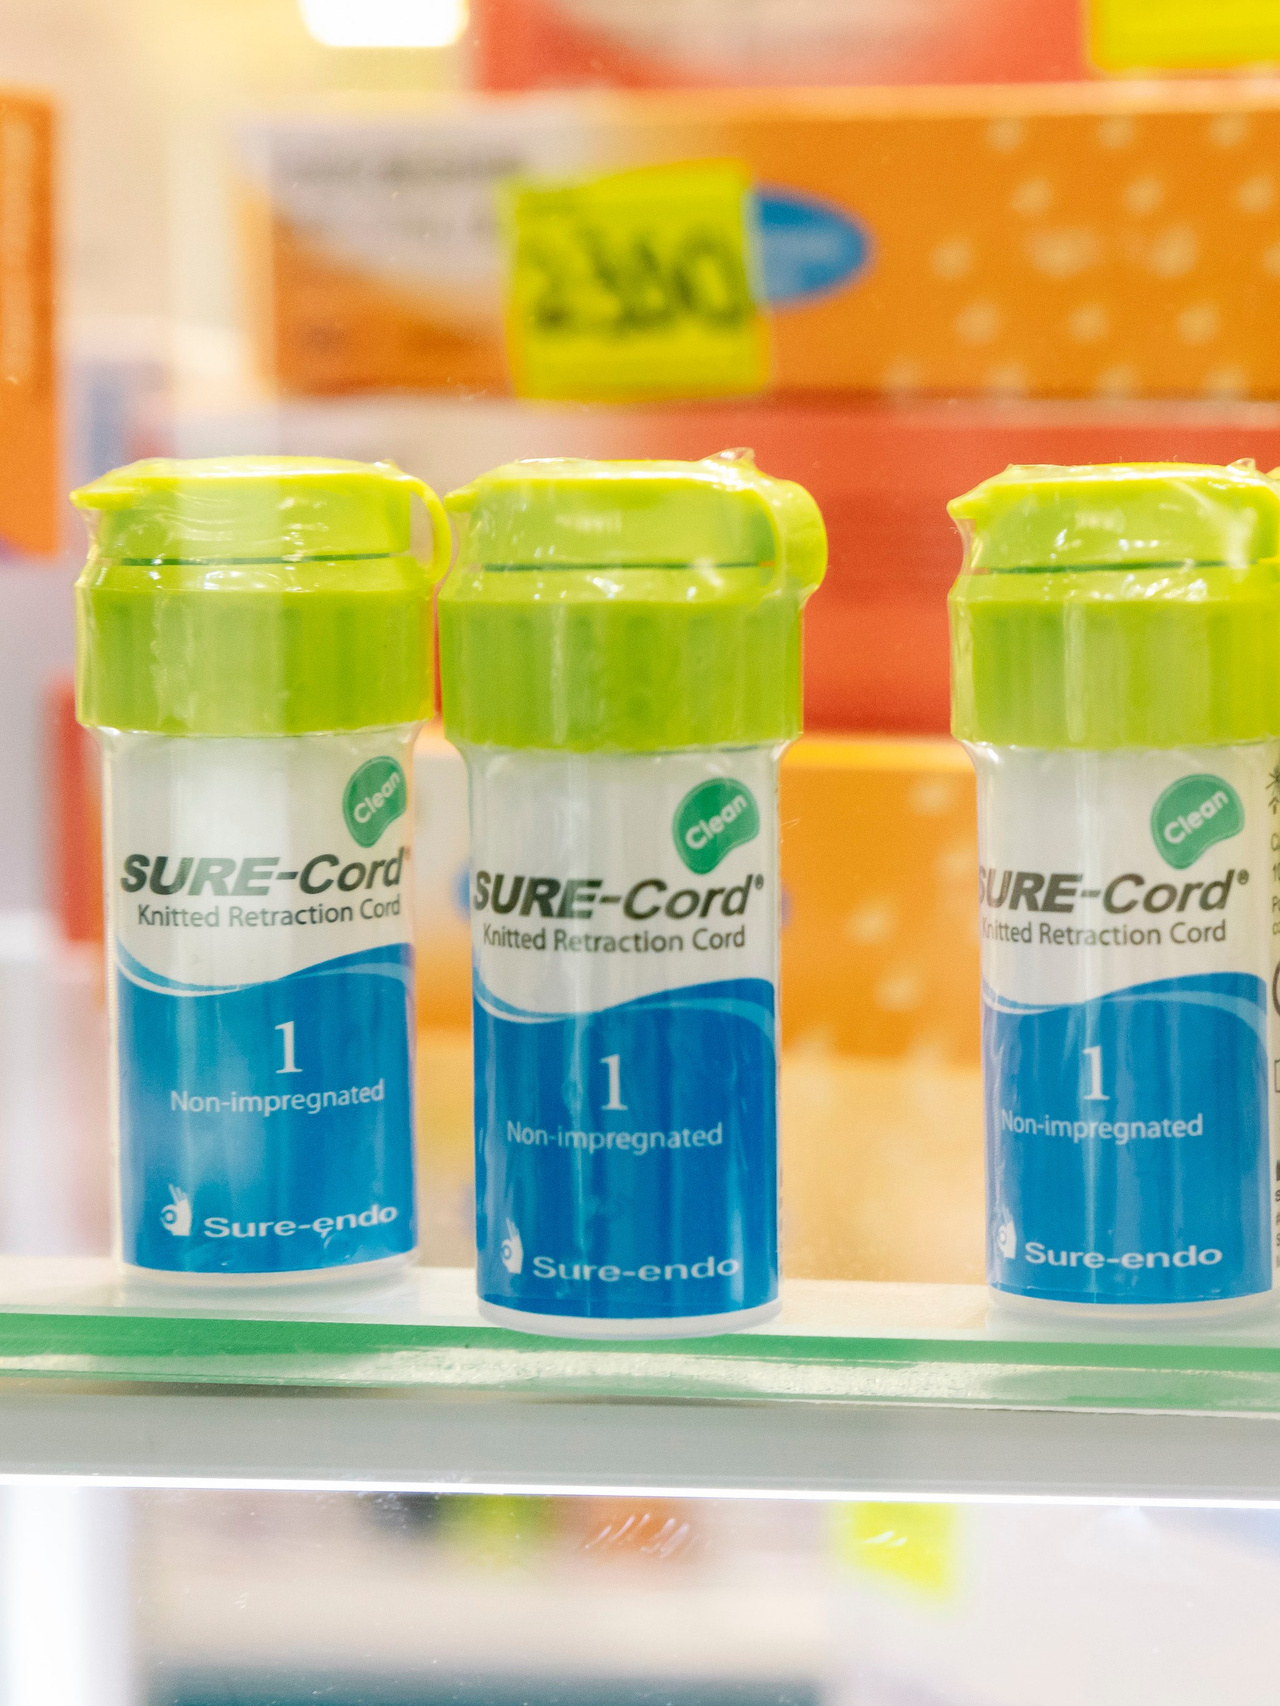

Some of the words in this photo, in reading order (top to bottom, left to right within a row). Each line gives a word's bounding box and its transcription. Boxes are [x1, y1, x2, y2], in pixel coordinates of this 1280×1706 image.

[352, 770, 401, 825] Clean
[685, 794, 747, 849] Clean
[1163, 790, 1229, 845] Clean
[138, 904, 220, 927] Knitted
[229, 904, 353, 927] Retraction
[360, 893, 400, 919] Cord
[483, 922, 546, 951] Knitted
[553, 928, 684, 953] Retraction
[692, 924, 745, 951] Cord
[1039, 921, 1162, 946] Retraction
[1170, 919, 1227, 945] Cord
[274, 1020, 303, 1074] 1
[600, 1053, 628, 1111] 1
[1083, 1045, 1110, 1101] 1
[169, 1078, 385, 1117] Non-impregnated
[506, 1120, 723, 1156] Non-impregnated
[1001, 1108, 1204, 1145] Non-impregnated
[204, 1204, 398, 1238] Sure-endo
[533, 1256, 740, 1282] Sure-endo
[1024, 1242, 1224, 1269] Sure-endo
